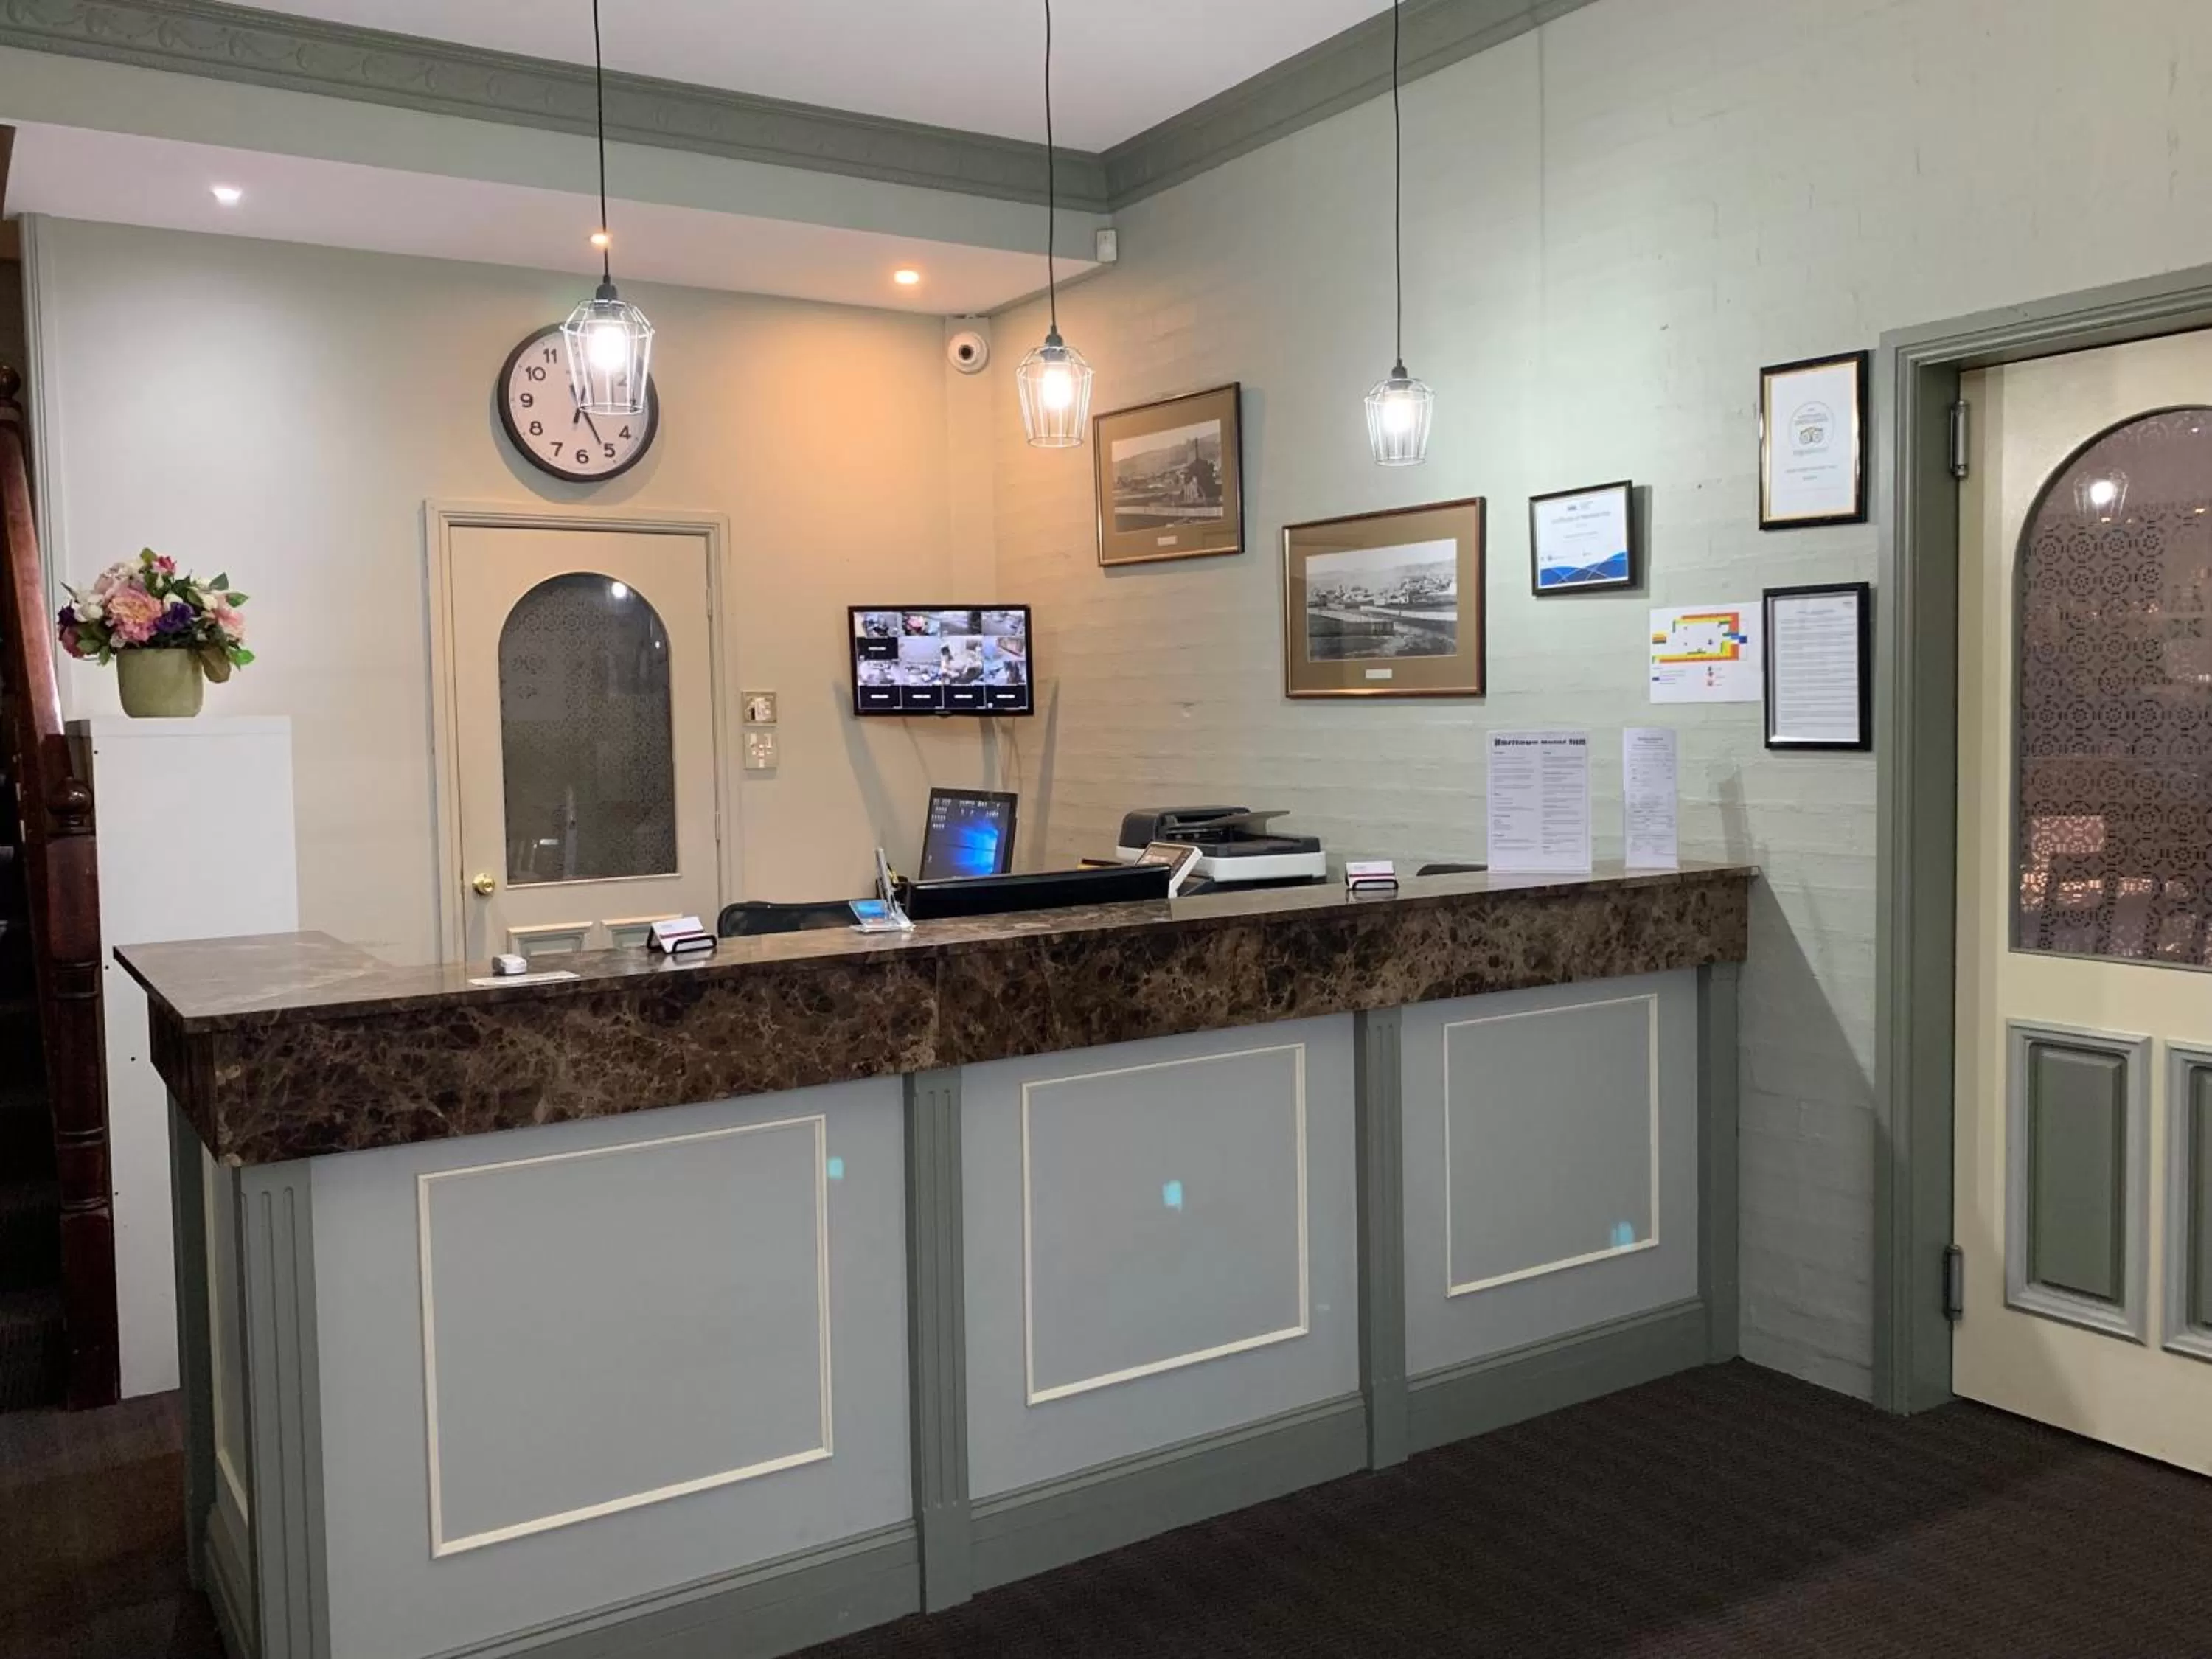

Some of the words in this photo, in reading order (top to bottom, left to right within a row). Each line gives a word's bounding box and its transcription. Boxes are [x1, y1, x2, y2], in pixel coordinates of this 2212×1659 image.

[543, 348, 557, 364] 11
[526, 366, 546, 381] 10
[520, 393, 534, 408] 9
[529, 421, 543, 436] 8
[619, 425, 631, 439] 4
[550, 442, 563, 456] 7
[576, 449, 589, 464] 6
[604, 443, 616, 458] 5
